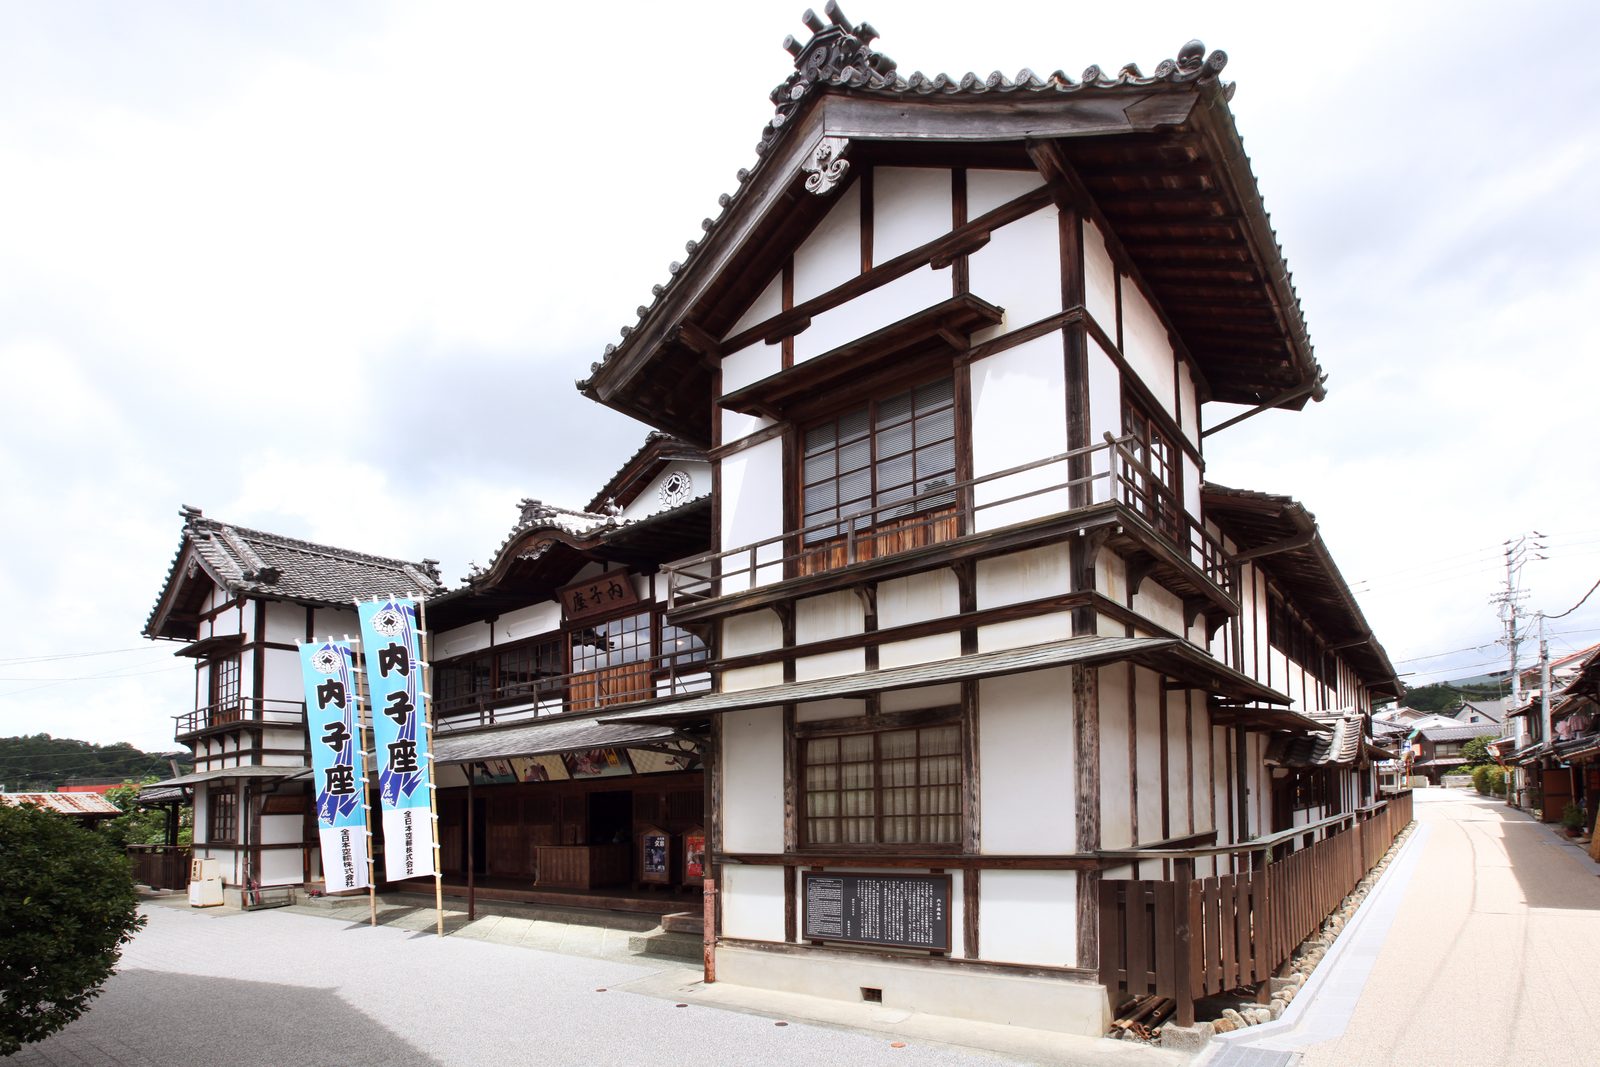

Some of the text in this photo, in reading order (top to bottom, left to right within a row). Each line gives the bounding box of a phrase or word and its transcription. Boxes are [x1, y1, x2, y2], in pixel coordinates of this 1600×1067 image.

[316, 679, 356, 796] 内子座
[378, 643, 419, 773] 内子座
[340, 829, 355, 888] 全日本空輸株式会社
[403, 810, 414, 875] 全日本空輸株式会社
